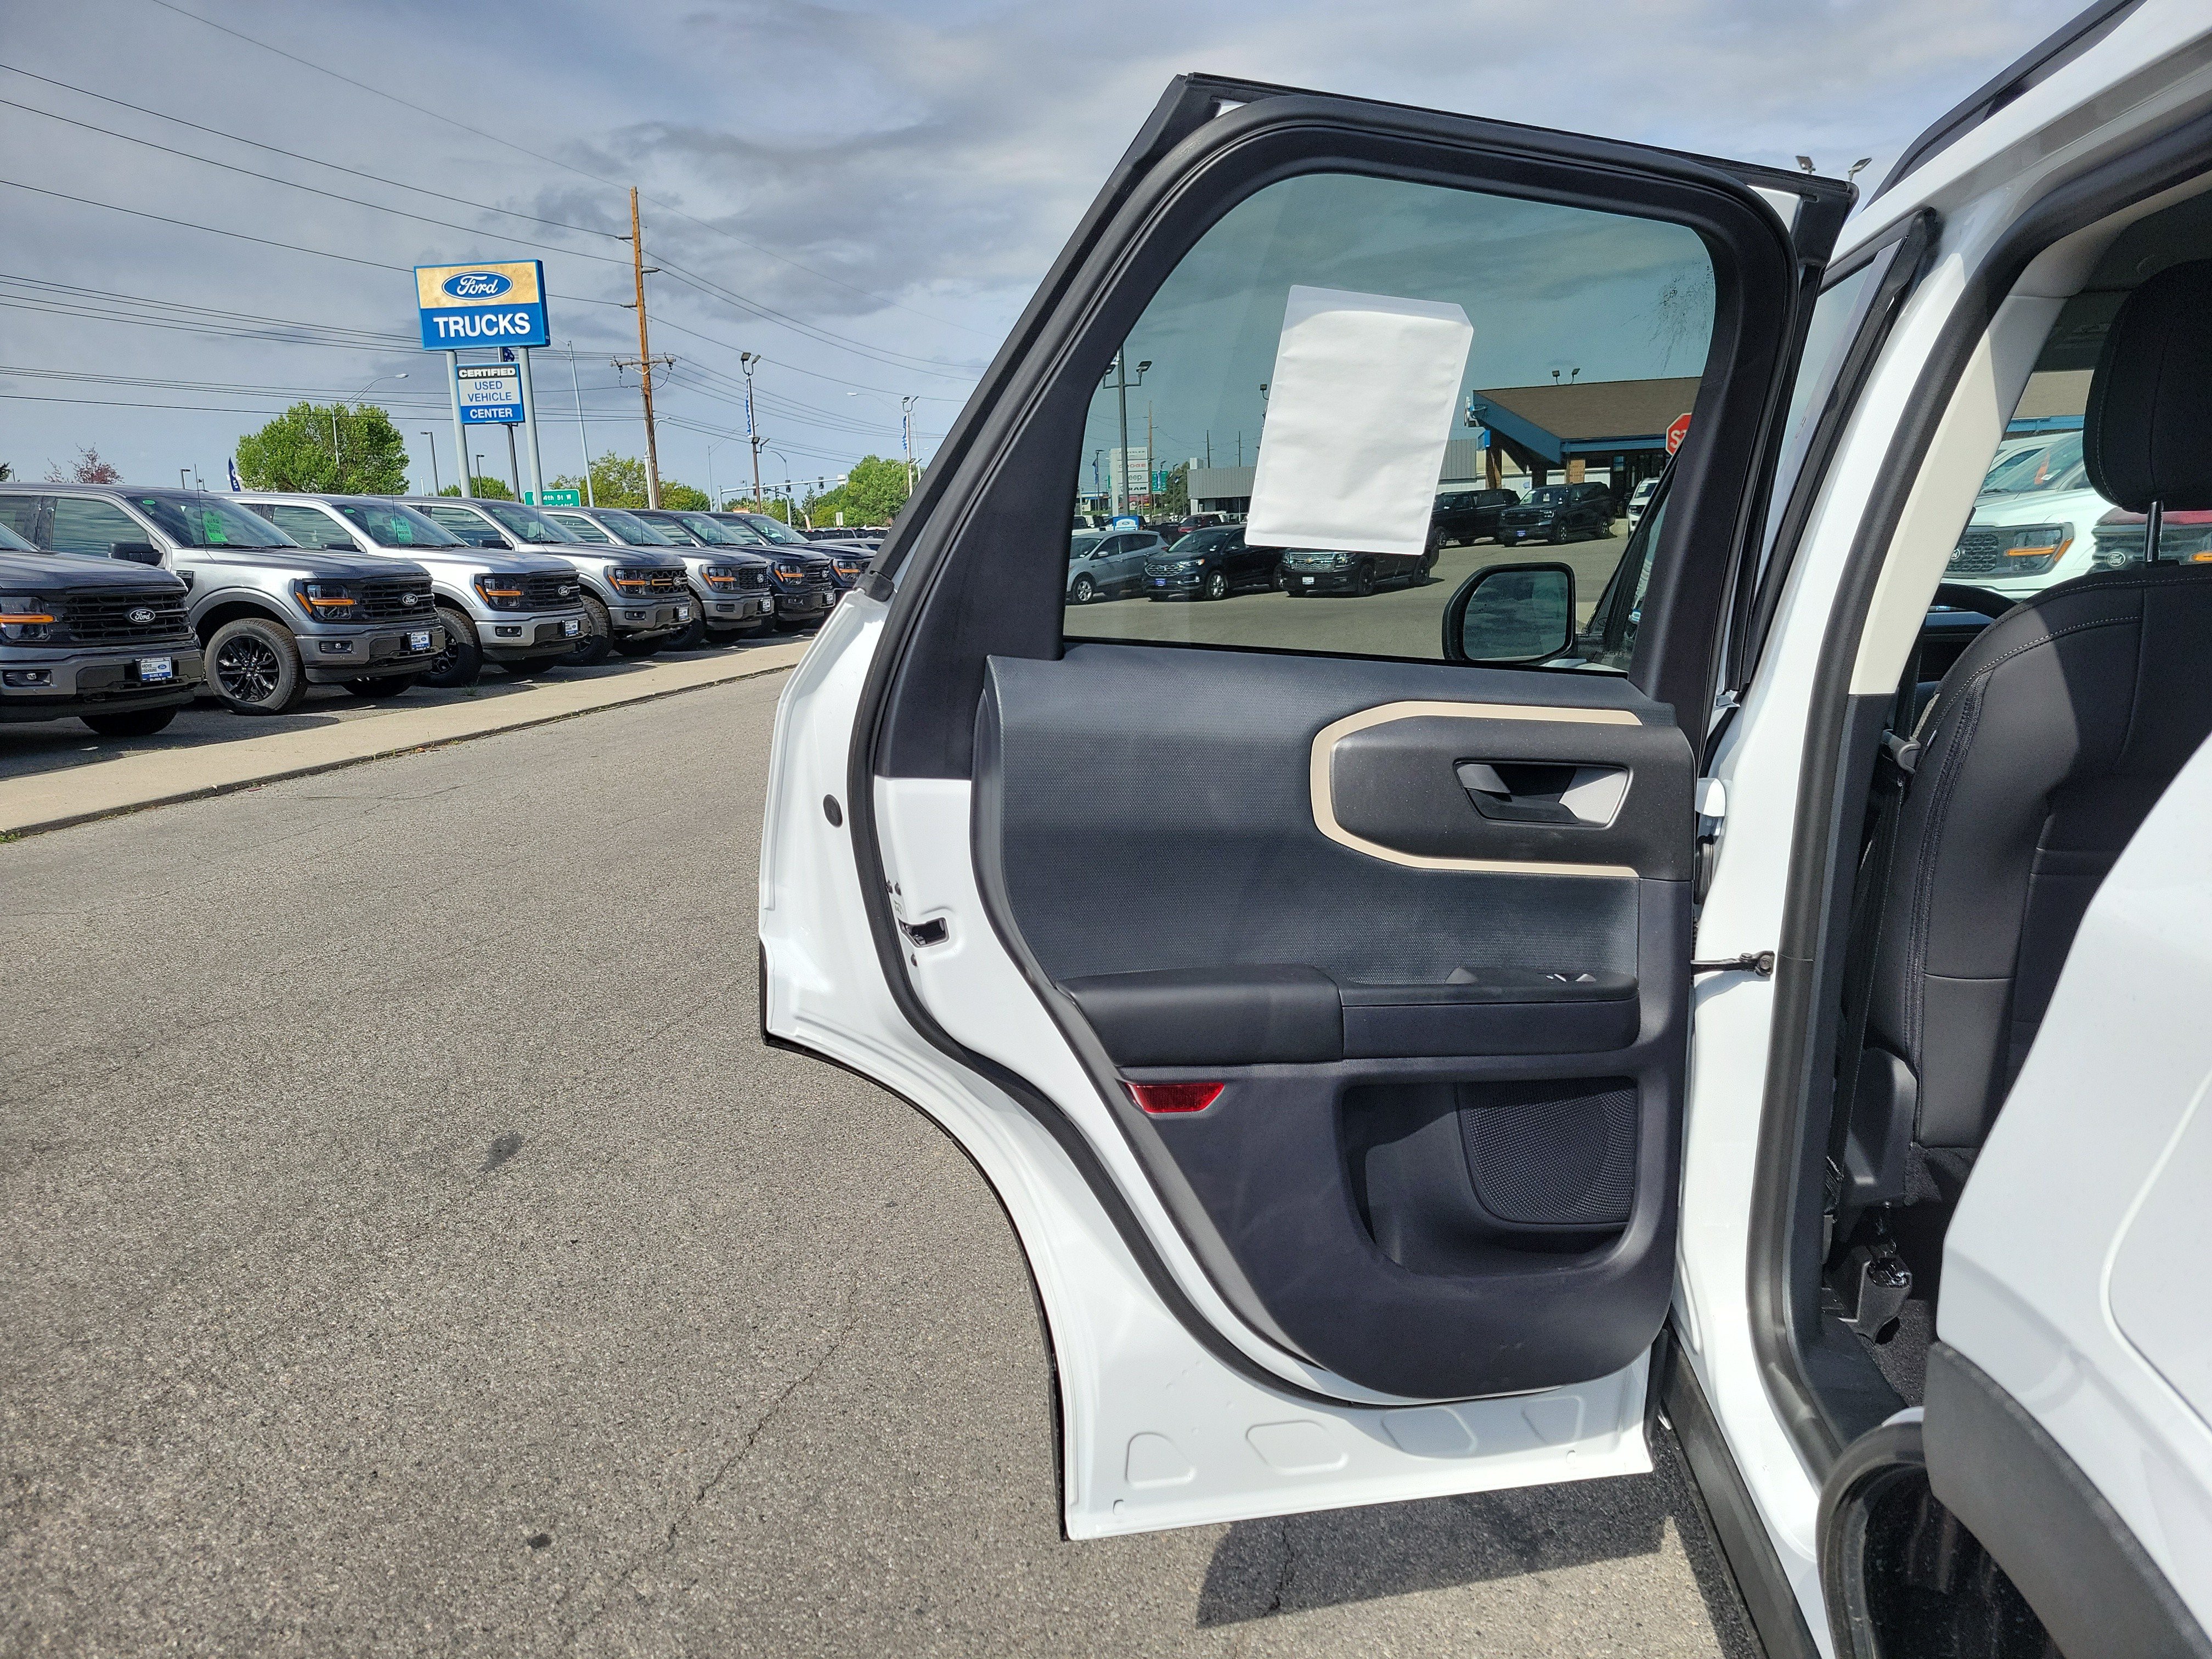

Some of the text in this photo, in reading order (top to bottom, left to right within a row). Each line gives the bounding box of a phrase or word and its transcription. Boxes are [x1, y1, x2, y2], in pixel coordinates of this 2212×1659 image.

[456, 275, 498, 295] Ford
[433, 312, 531, 338] TRUCKS
[459, 368, 516, 377] CERTIFIED
[475, 381, 503, 390] USED
[467, 392, 512, 402] VEHICLE
[470, 408, 513, 419] CENTER
[135, 611, 151, 620] Ford
